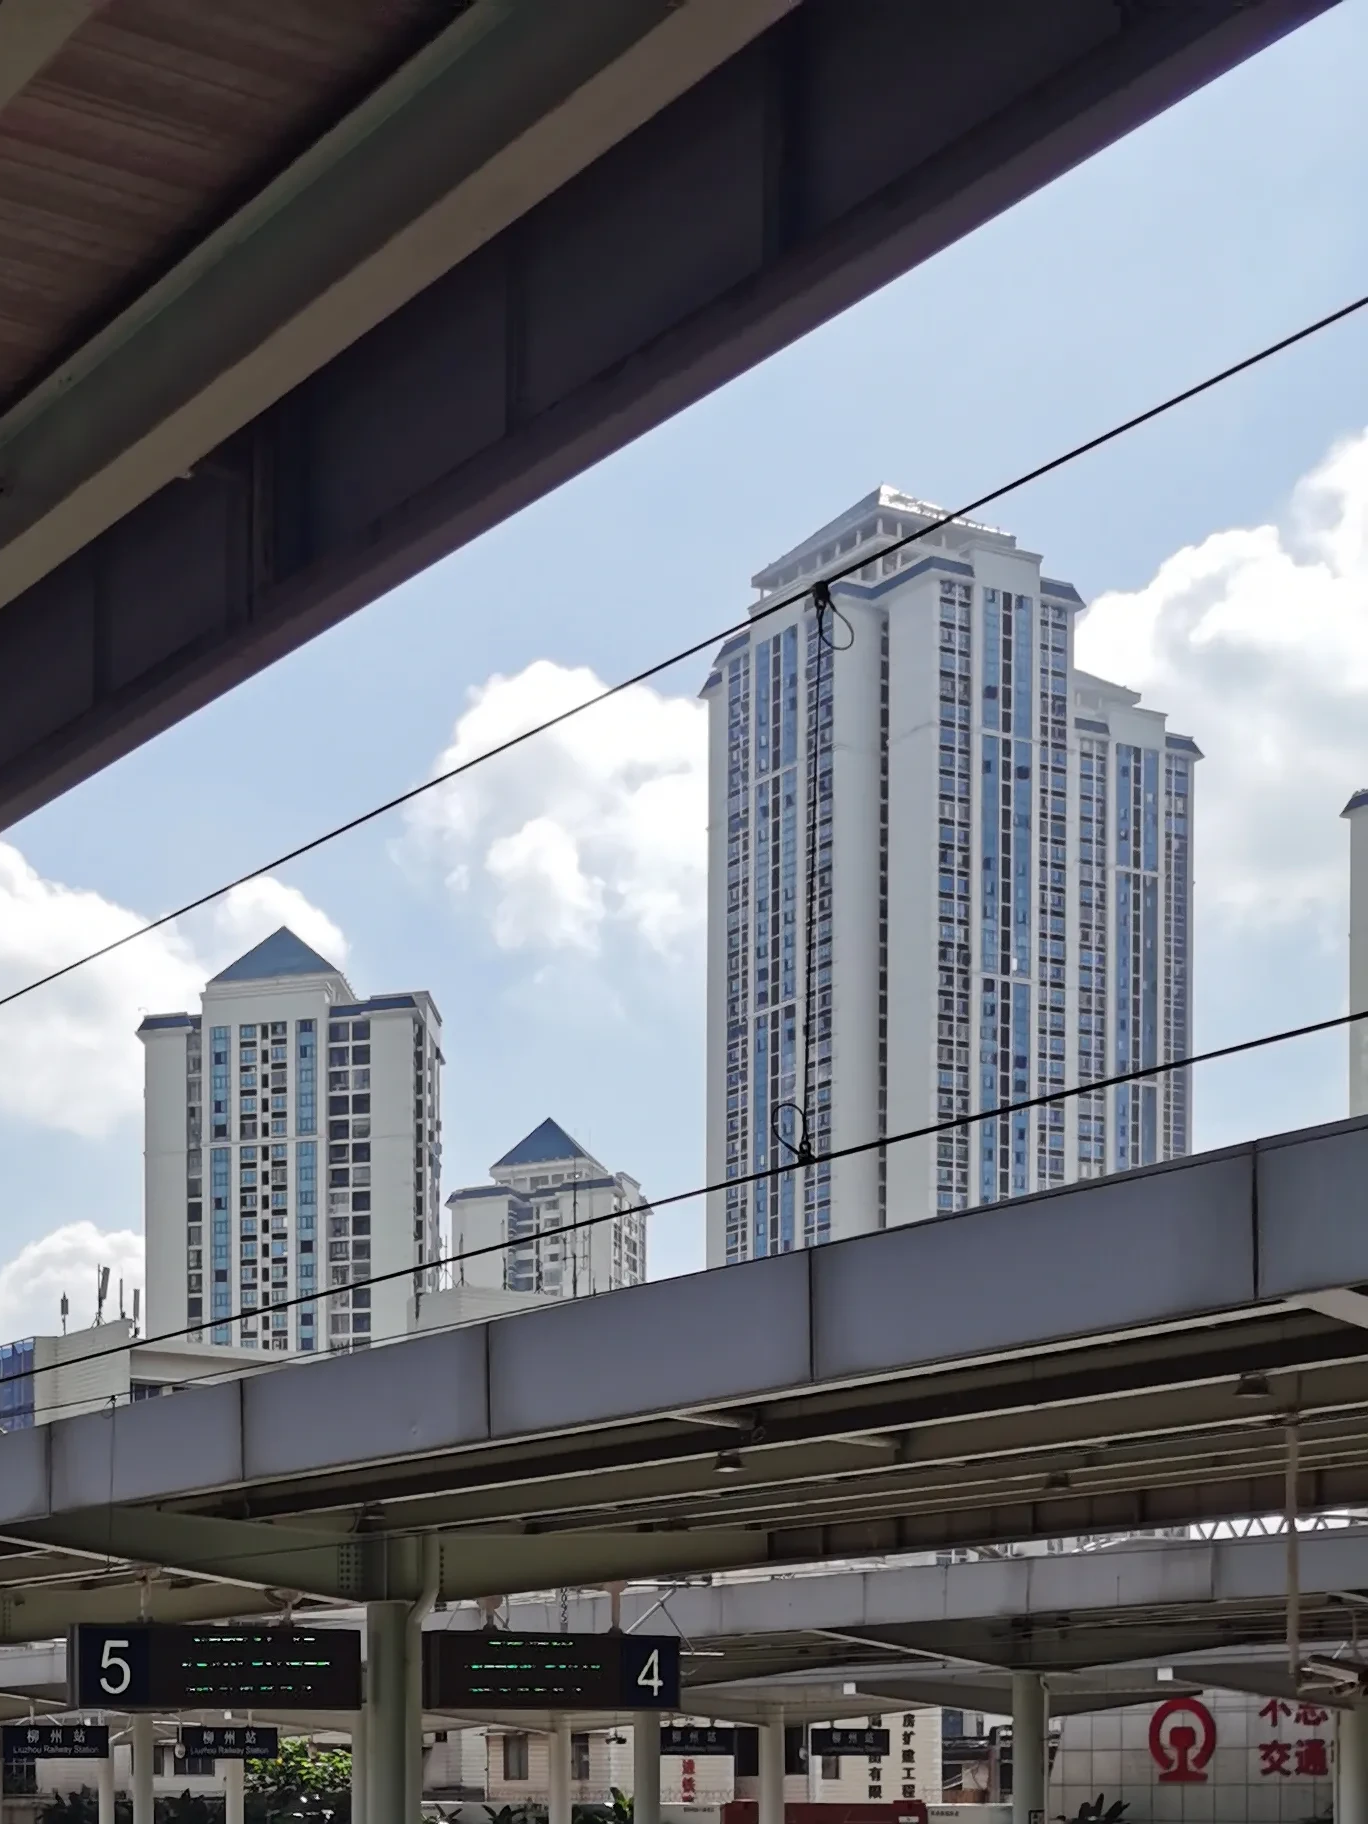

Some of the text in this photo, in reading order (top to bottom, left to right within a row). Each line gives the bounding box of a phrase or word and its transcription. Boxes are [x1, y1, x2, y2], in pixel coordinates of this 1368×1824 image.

[99, 1639, 132, 1695] 5
[637, 1648, 664, 1697] 4
[27, 1728, 86, 1743] 柳州站
[202, 1730, 257, 1745] 柳州站
[13, 1745, 42, 1754] Liuzhou
[43, 1745, 72, 1755] Railway
[1258, 1738, 1335, 1777] 交通
